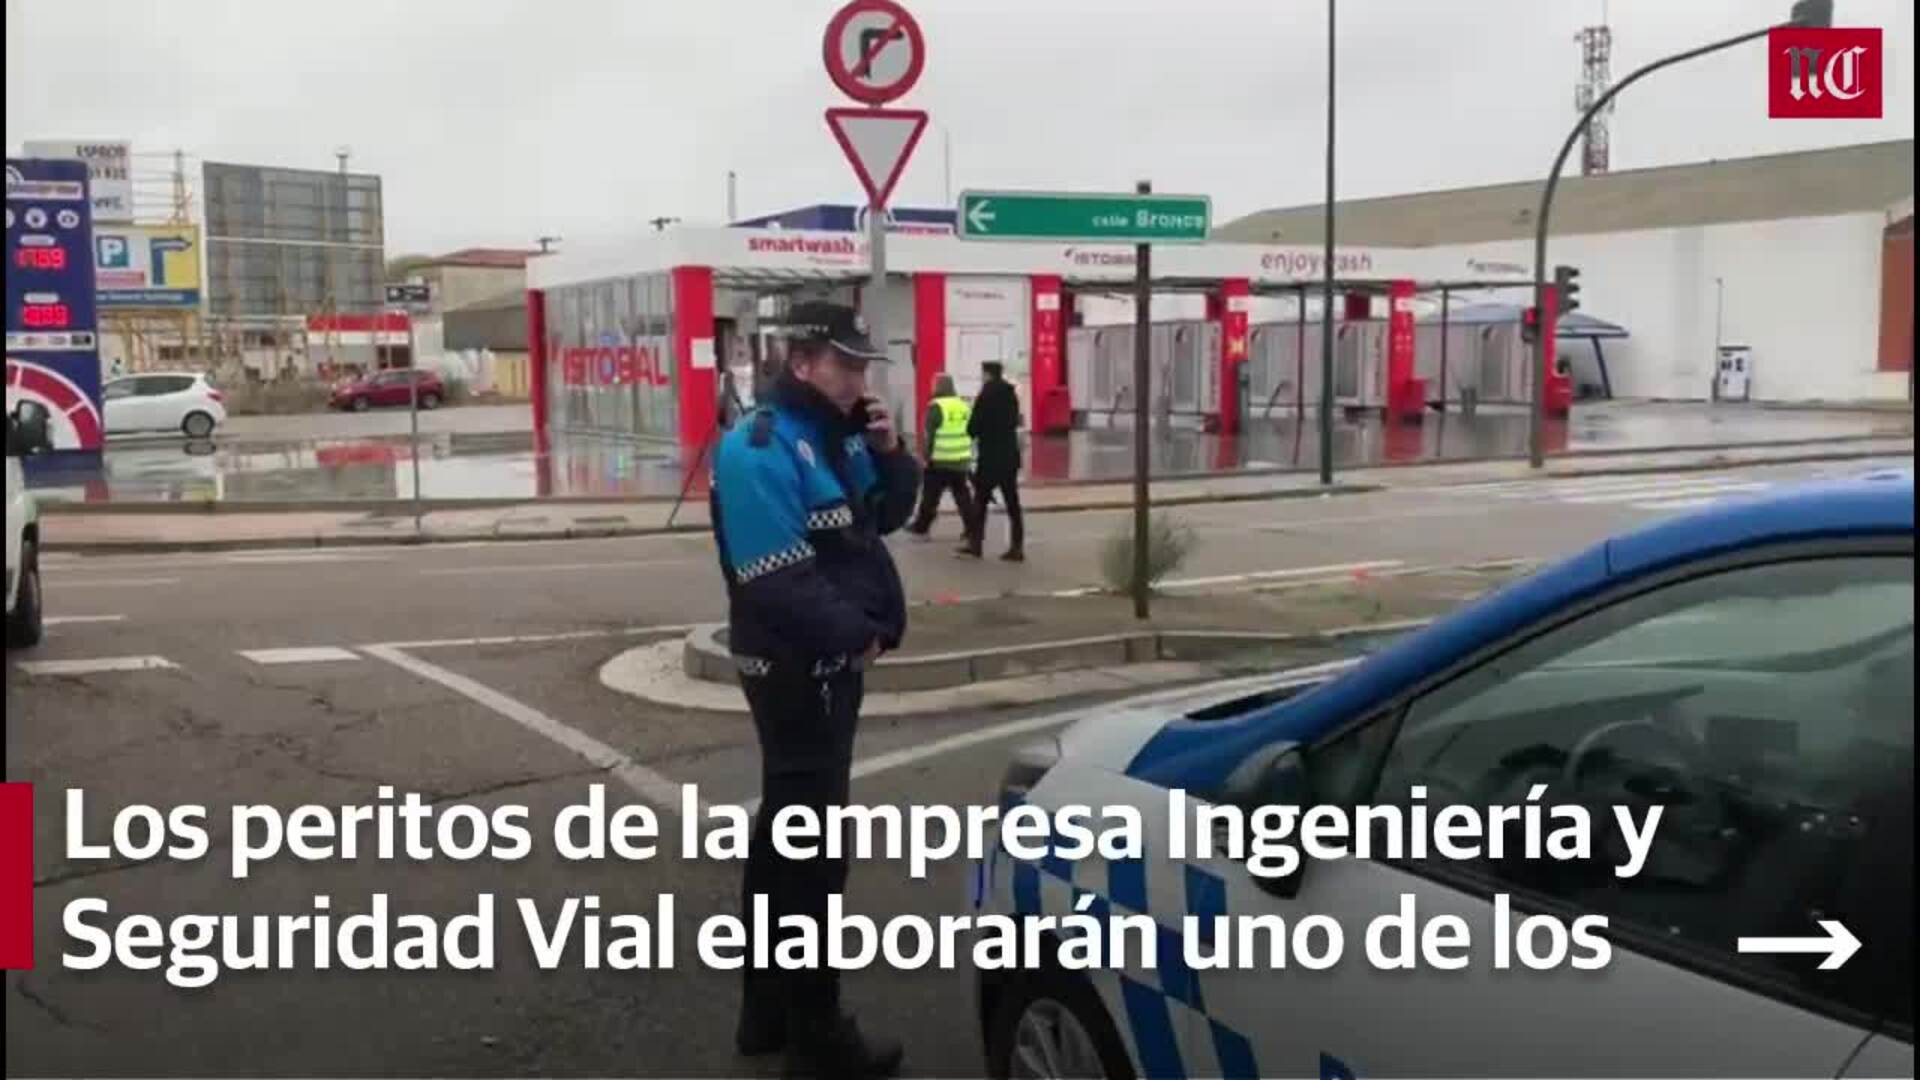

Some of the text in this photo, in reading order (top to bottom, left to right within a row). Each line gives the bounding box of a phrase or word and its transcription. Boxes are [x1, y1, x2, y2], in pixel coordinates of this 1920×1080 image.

[1091, 209, 1203, 229] calle Bronce
[101, 238, 124, 265] P
[747, 235, 855, 254] smartwash
